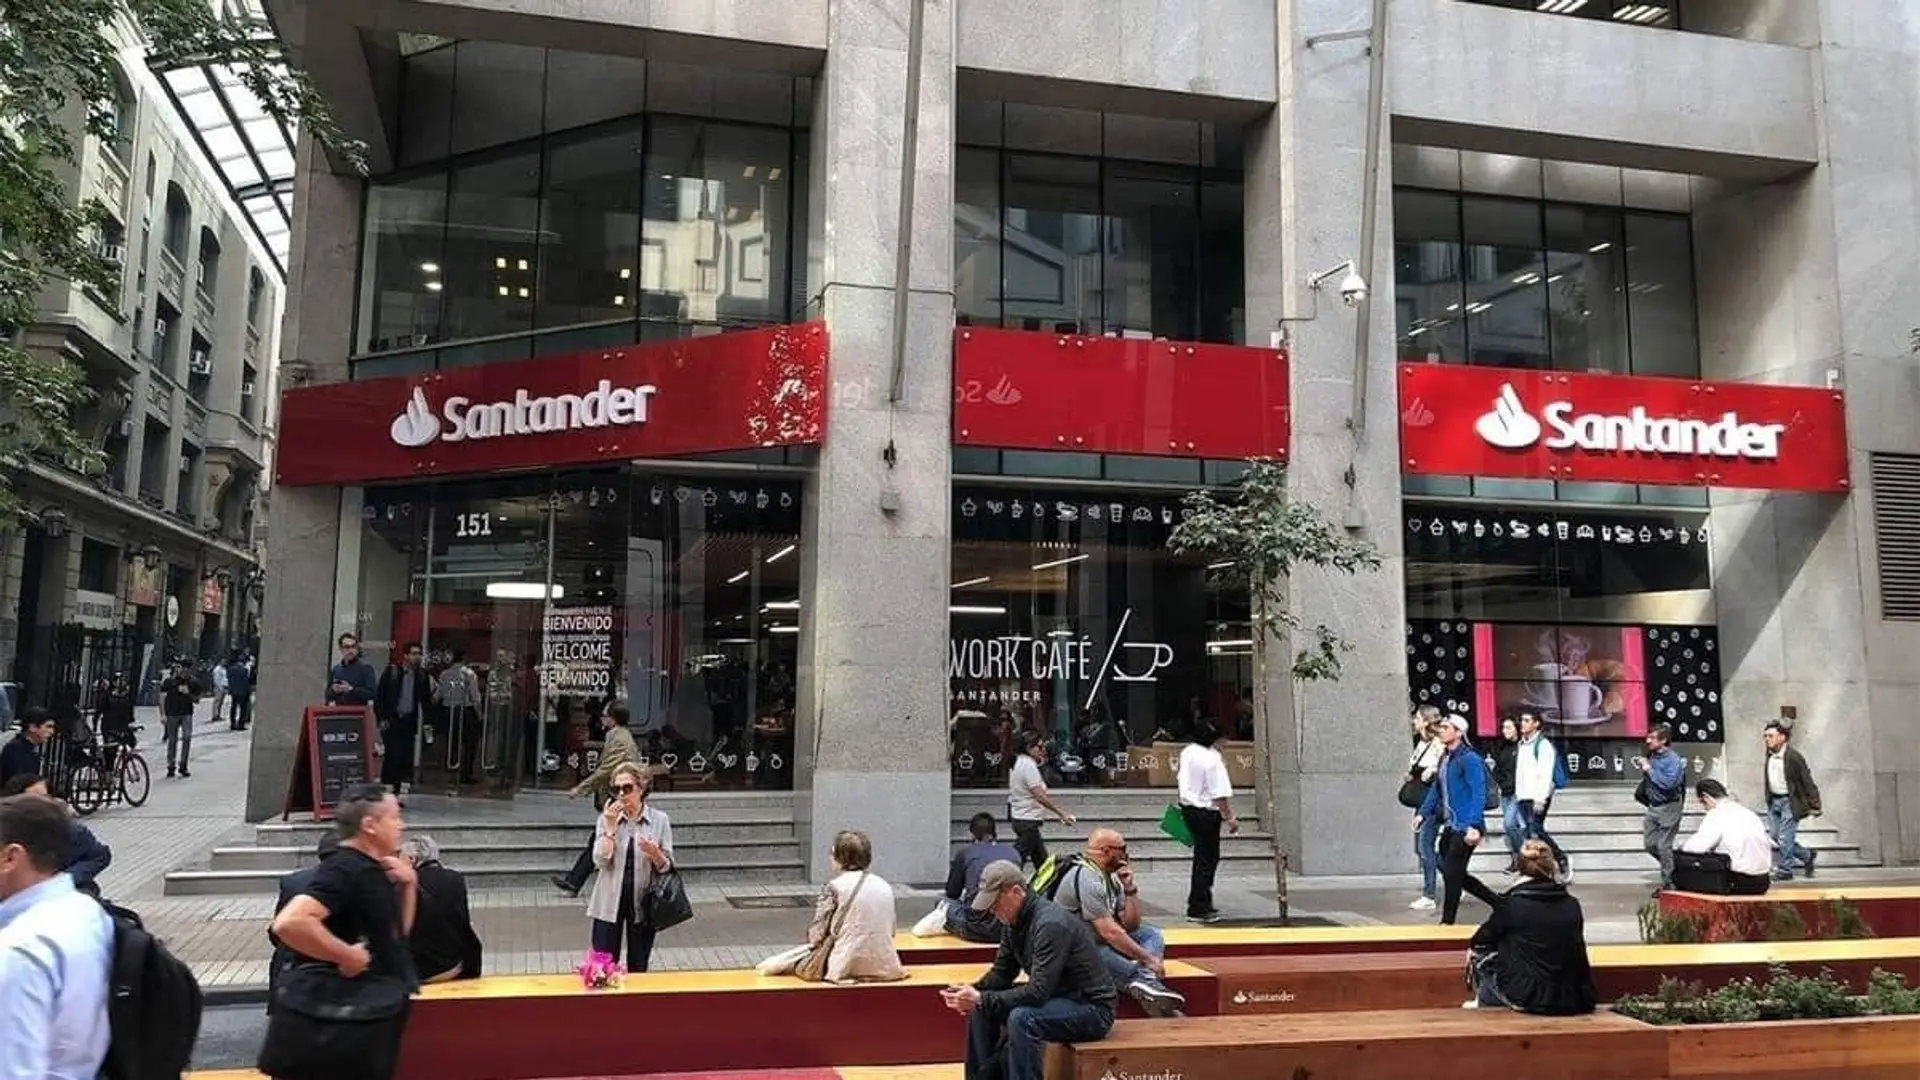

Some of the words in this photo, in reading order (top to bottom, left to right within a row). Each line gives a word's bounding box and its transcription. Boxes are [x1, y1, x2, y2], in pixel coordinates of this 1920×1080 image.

[442, 379, 656, 442] Santander
[1543, 401, 1785, 458] Santander
[456, 512, 492, 537] 151
[543, 615, 613, 631] BIENVENIDO
[542, 642, 612, 661] WELCOME
[1031, 634, 1092, 680] CAFÉ
[540, 670, 610, 687] BEM-VINDO
[1248, 990, 1295, 1003] Santander
